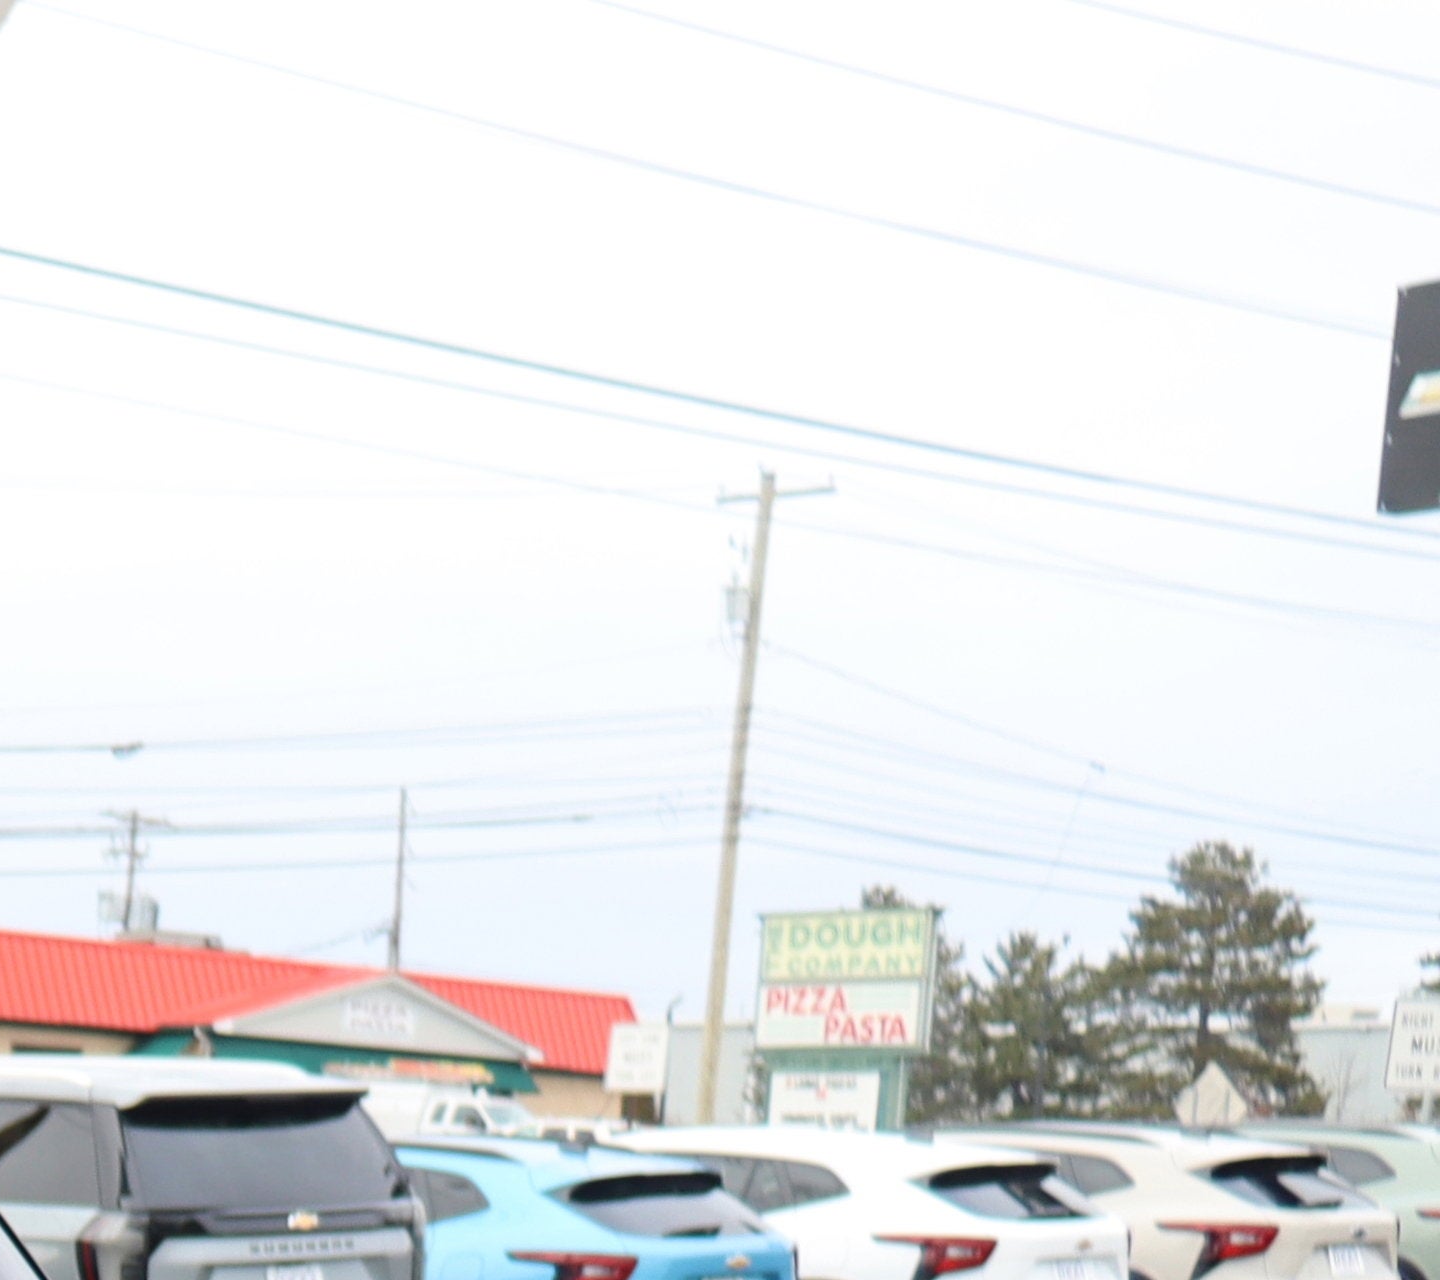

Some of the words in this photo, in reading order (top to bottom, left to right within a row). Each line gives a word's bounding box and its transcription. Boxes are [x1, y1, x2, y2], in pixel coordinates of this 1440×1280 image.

[790, 919, 921, 950] DOUGH
[787, 955, 920, 977] COMPANY
[766, 986, 847, 1016] PIZZA
[824, 1014, 908, 1044] PASTA
